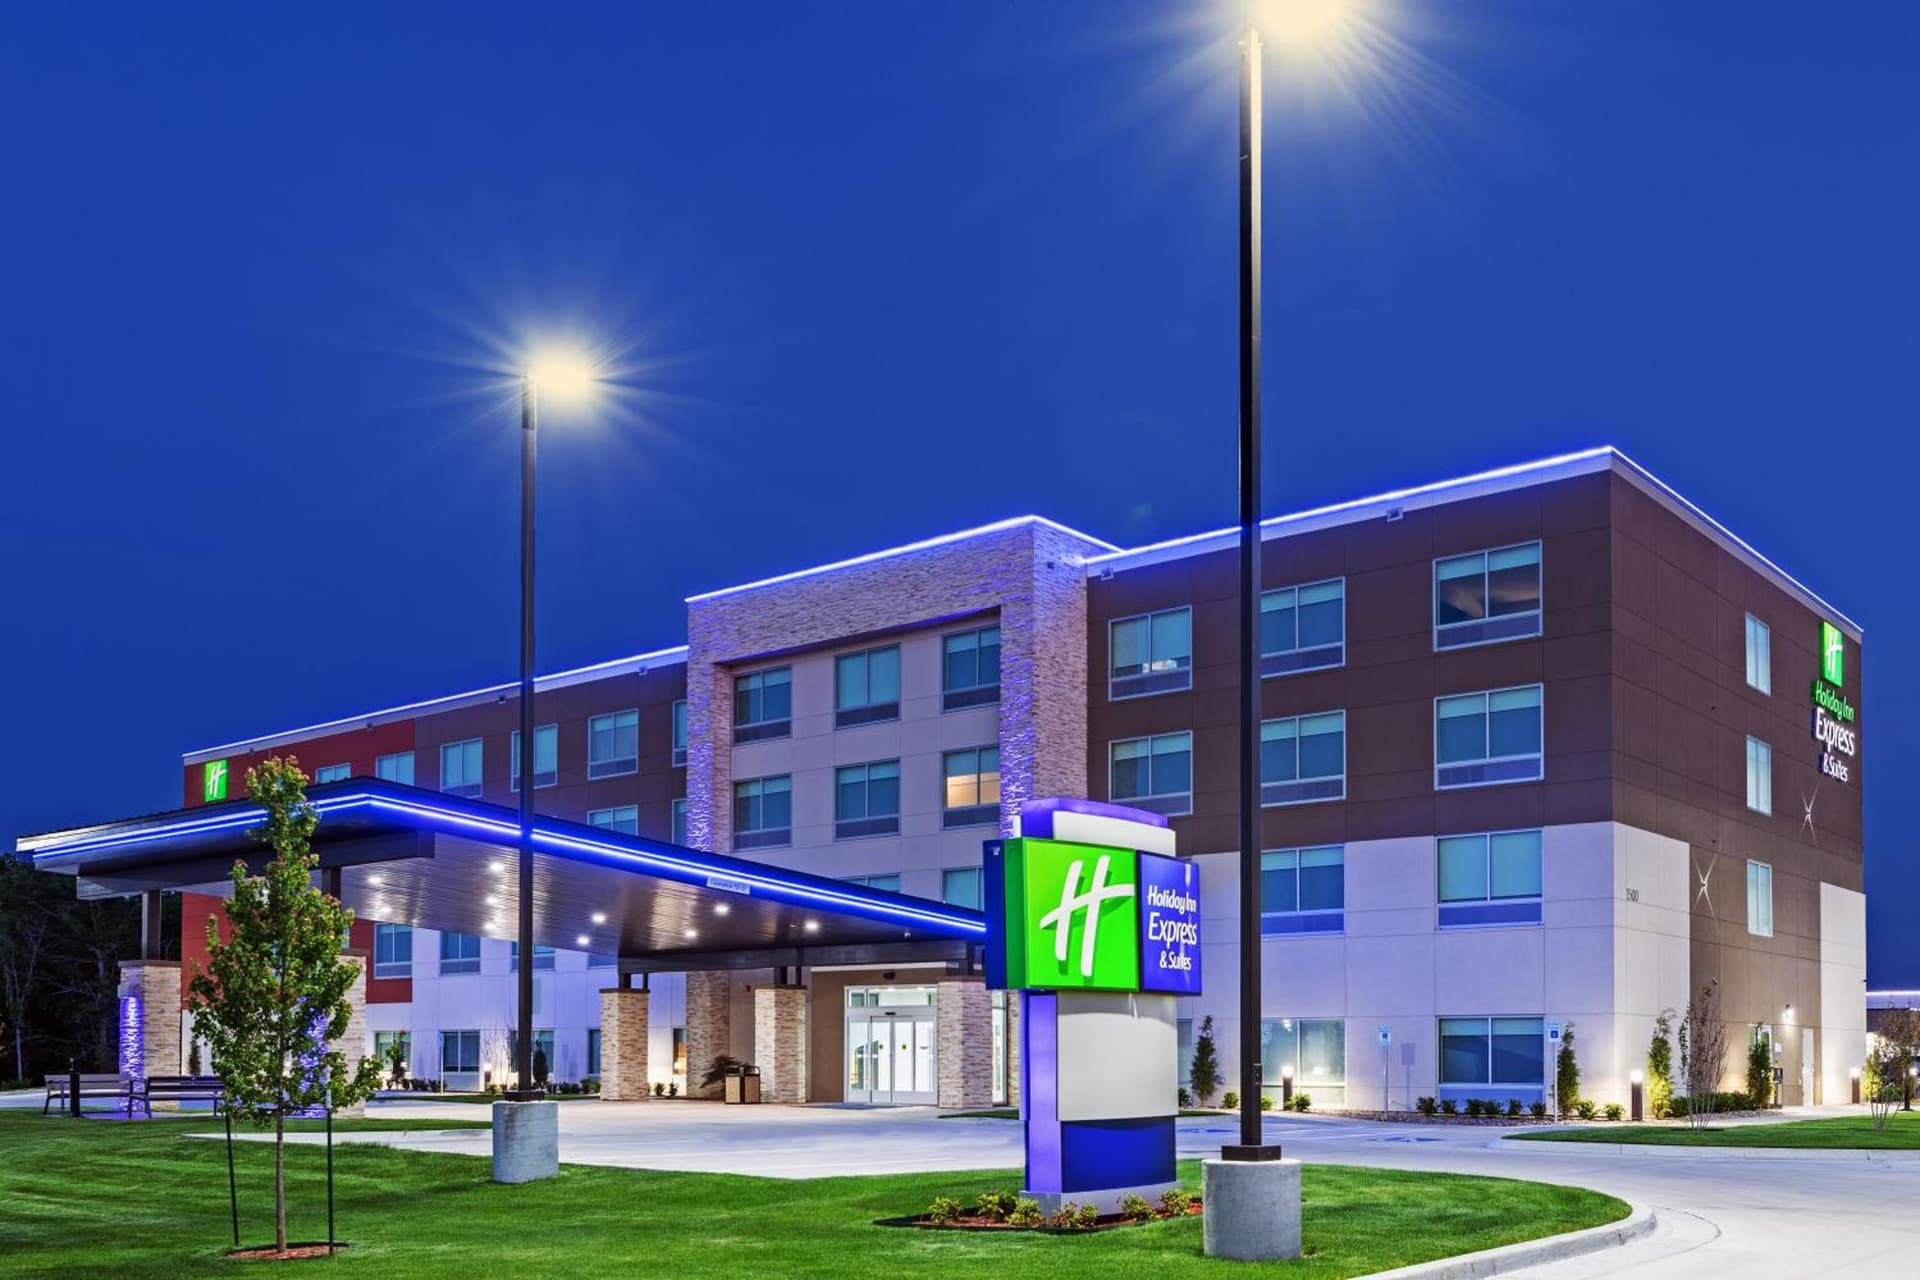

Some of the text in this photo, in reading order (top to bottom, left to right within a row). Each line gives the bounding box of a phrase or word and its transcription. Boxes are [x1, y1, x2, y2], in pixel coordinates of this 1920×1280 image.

[1815, 679, 1855, 722] Holiday Inn
[1815, 706, 1855, 757] Express
[1822, 752, 1848, 783] & Suites
[1147, 884, 1197, 915] Holiday Inn
[1148, 911, 1198, 949] Express
[1159, 950, 1192, 971] & Suites
